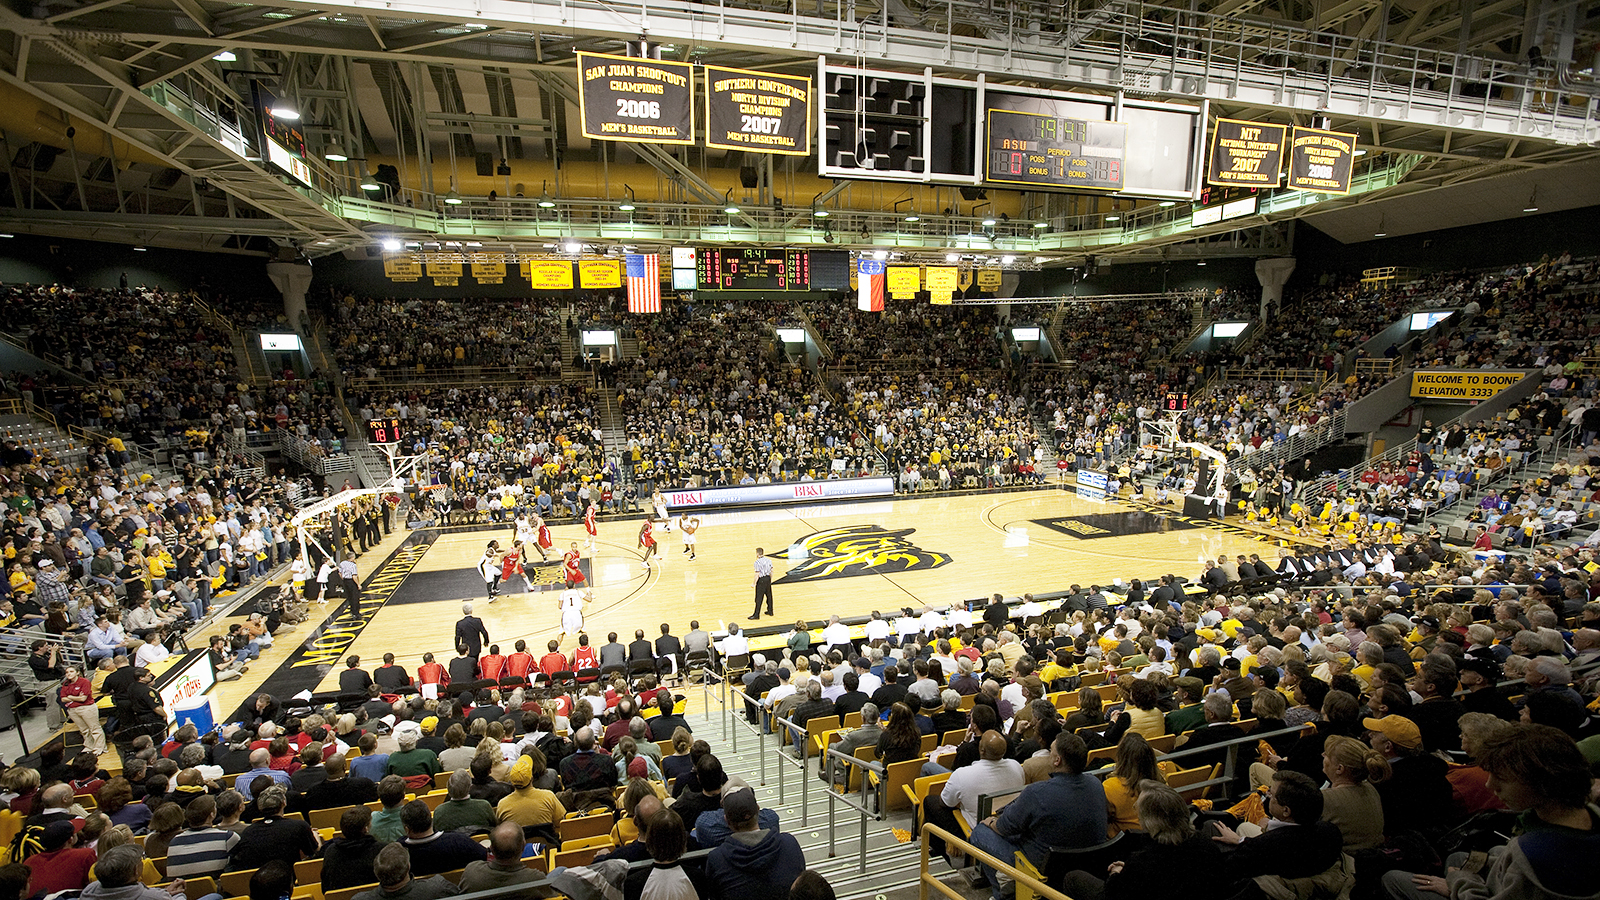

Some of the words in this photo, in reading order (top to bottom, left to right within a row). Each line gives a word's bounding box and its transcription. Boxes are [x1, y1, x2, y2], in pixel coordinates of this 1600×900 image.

[585, 65, 606, 81] SAN
[607, 64, 635, 77] JUAN
[636, 65, 687, 88] SHOOTOUT
[609, 80, 664, 95] CHAMPIONS
[714, 78, 756, 92] SOUTHERN
[757, 79, 806, 103] CONFERENCE
[731, 92, 757, 104] NORTH
[758, 95, 791, 107] DIVISION
[616, 98, 661, 120] 2006
[739, 104, 782, 117] CHAMPIONS
[600, 122, 627, 134] MEN'S
[627, 124, 678, 136] BASKETBALL
[741, 115, 781, 135] 2007
[1041, 119, 1086, 142] 19:41
[726, 131, 749, 143] MEN'S
[750, 134, 796, 147] BASKETBALL
[1240, 126, 1262, 141] NIT
[1003, 139, 1027, 151] ASU
[1219, 138, 1247, 149] NATIONAL
[1047, 148, 1071, 157] PERIOD
[1228, 147, 1268, 159] TOURNAMENT
[1030, 155, 1045, 164] POSS
[1072, 158, 1087, 167] POSS
[1231, 157, 1261, 172] 2007
[1029, 166, 1049, 176] BONUS
[1068, 170, 1087, 178] BONUS
[1237, 173, 1270, 182] BASKETBALL
[744, 249, 767, 259] 19:41
[1417, 375, 1463, 384] WELCOME
[1467, 376, 1479, 384] TO
[1419, 387, 1466, 396] ELEVATION
[1470, 388, 1492, 397] 3333
[375, 429, 386, 442] 18
[794, 485, 823, 496] BB&T
[672, 491, 704, 505] BB&T
[578, 658, 592, 670] 22
